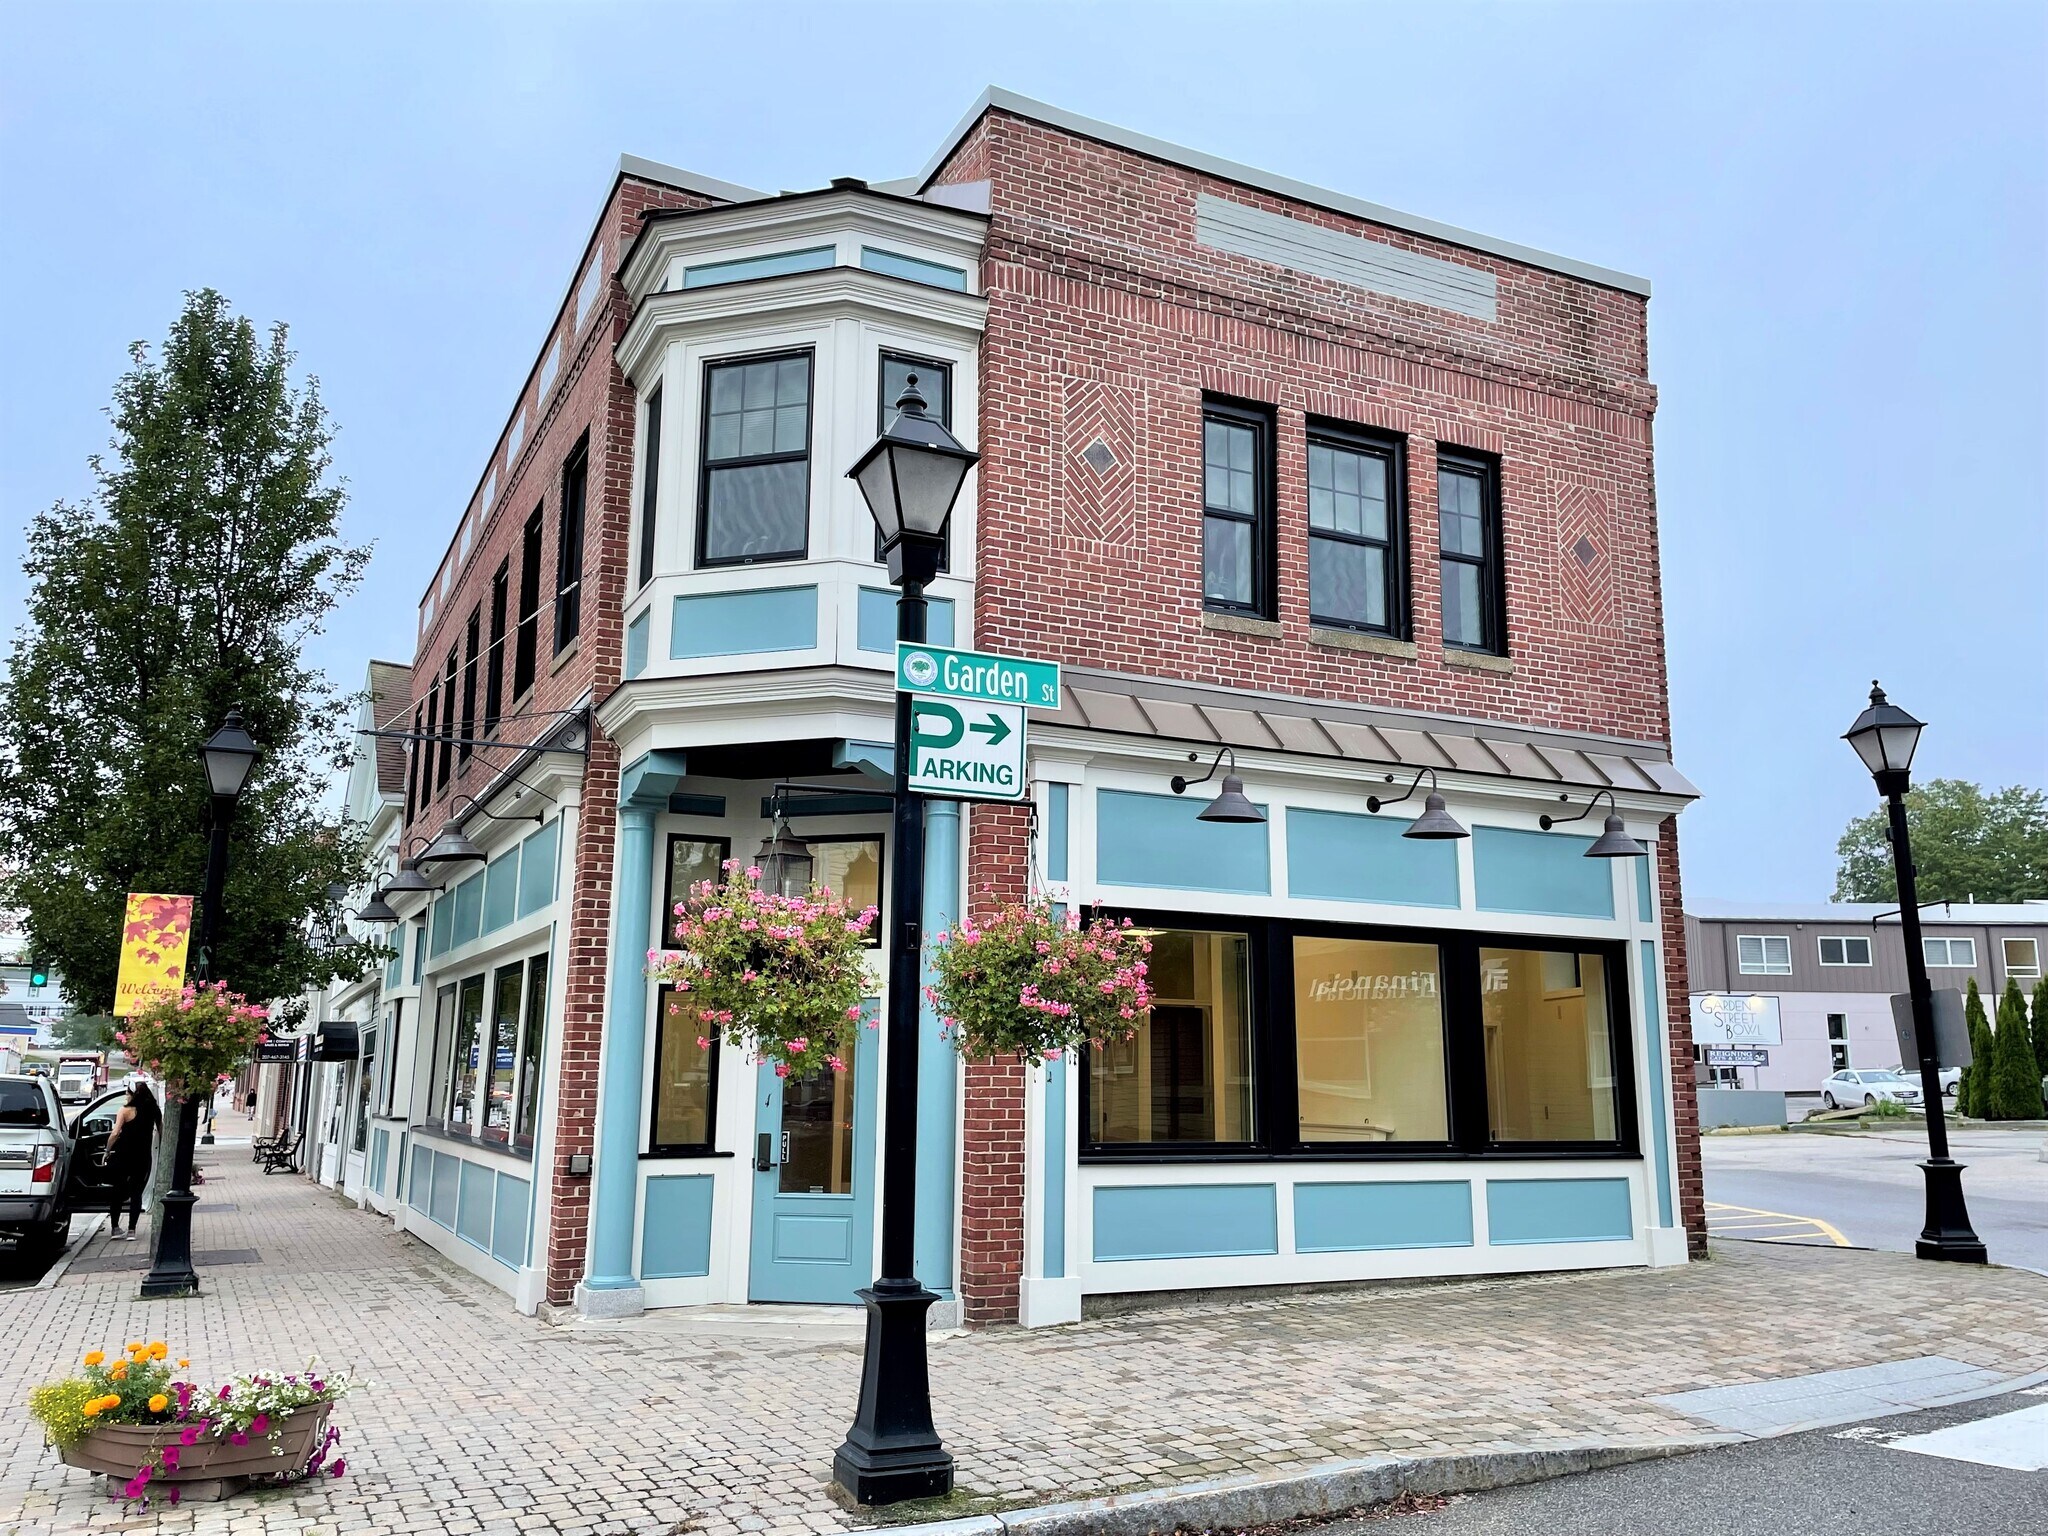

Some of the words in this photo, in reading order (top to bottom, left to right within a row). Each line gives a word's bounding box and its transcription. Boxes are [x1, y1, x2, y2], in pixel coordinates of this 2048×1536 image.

[943, 654, 1029, 700] Garden
[1041, 683, 1055, 703] St
[1699, 998, 1752, 1015] GARDEN
[1714, 1011, 1757, 1028] STREET
[1725, 1024, 1764, 1040] BOWL
